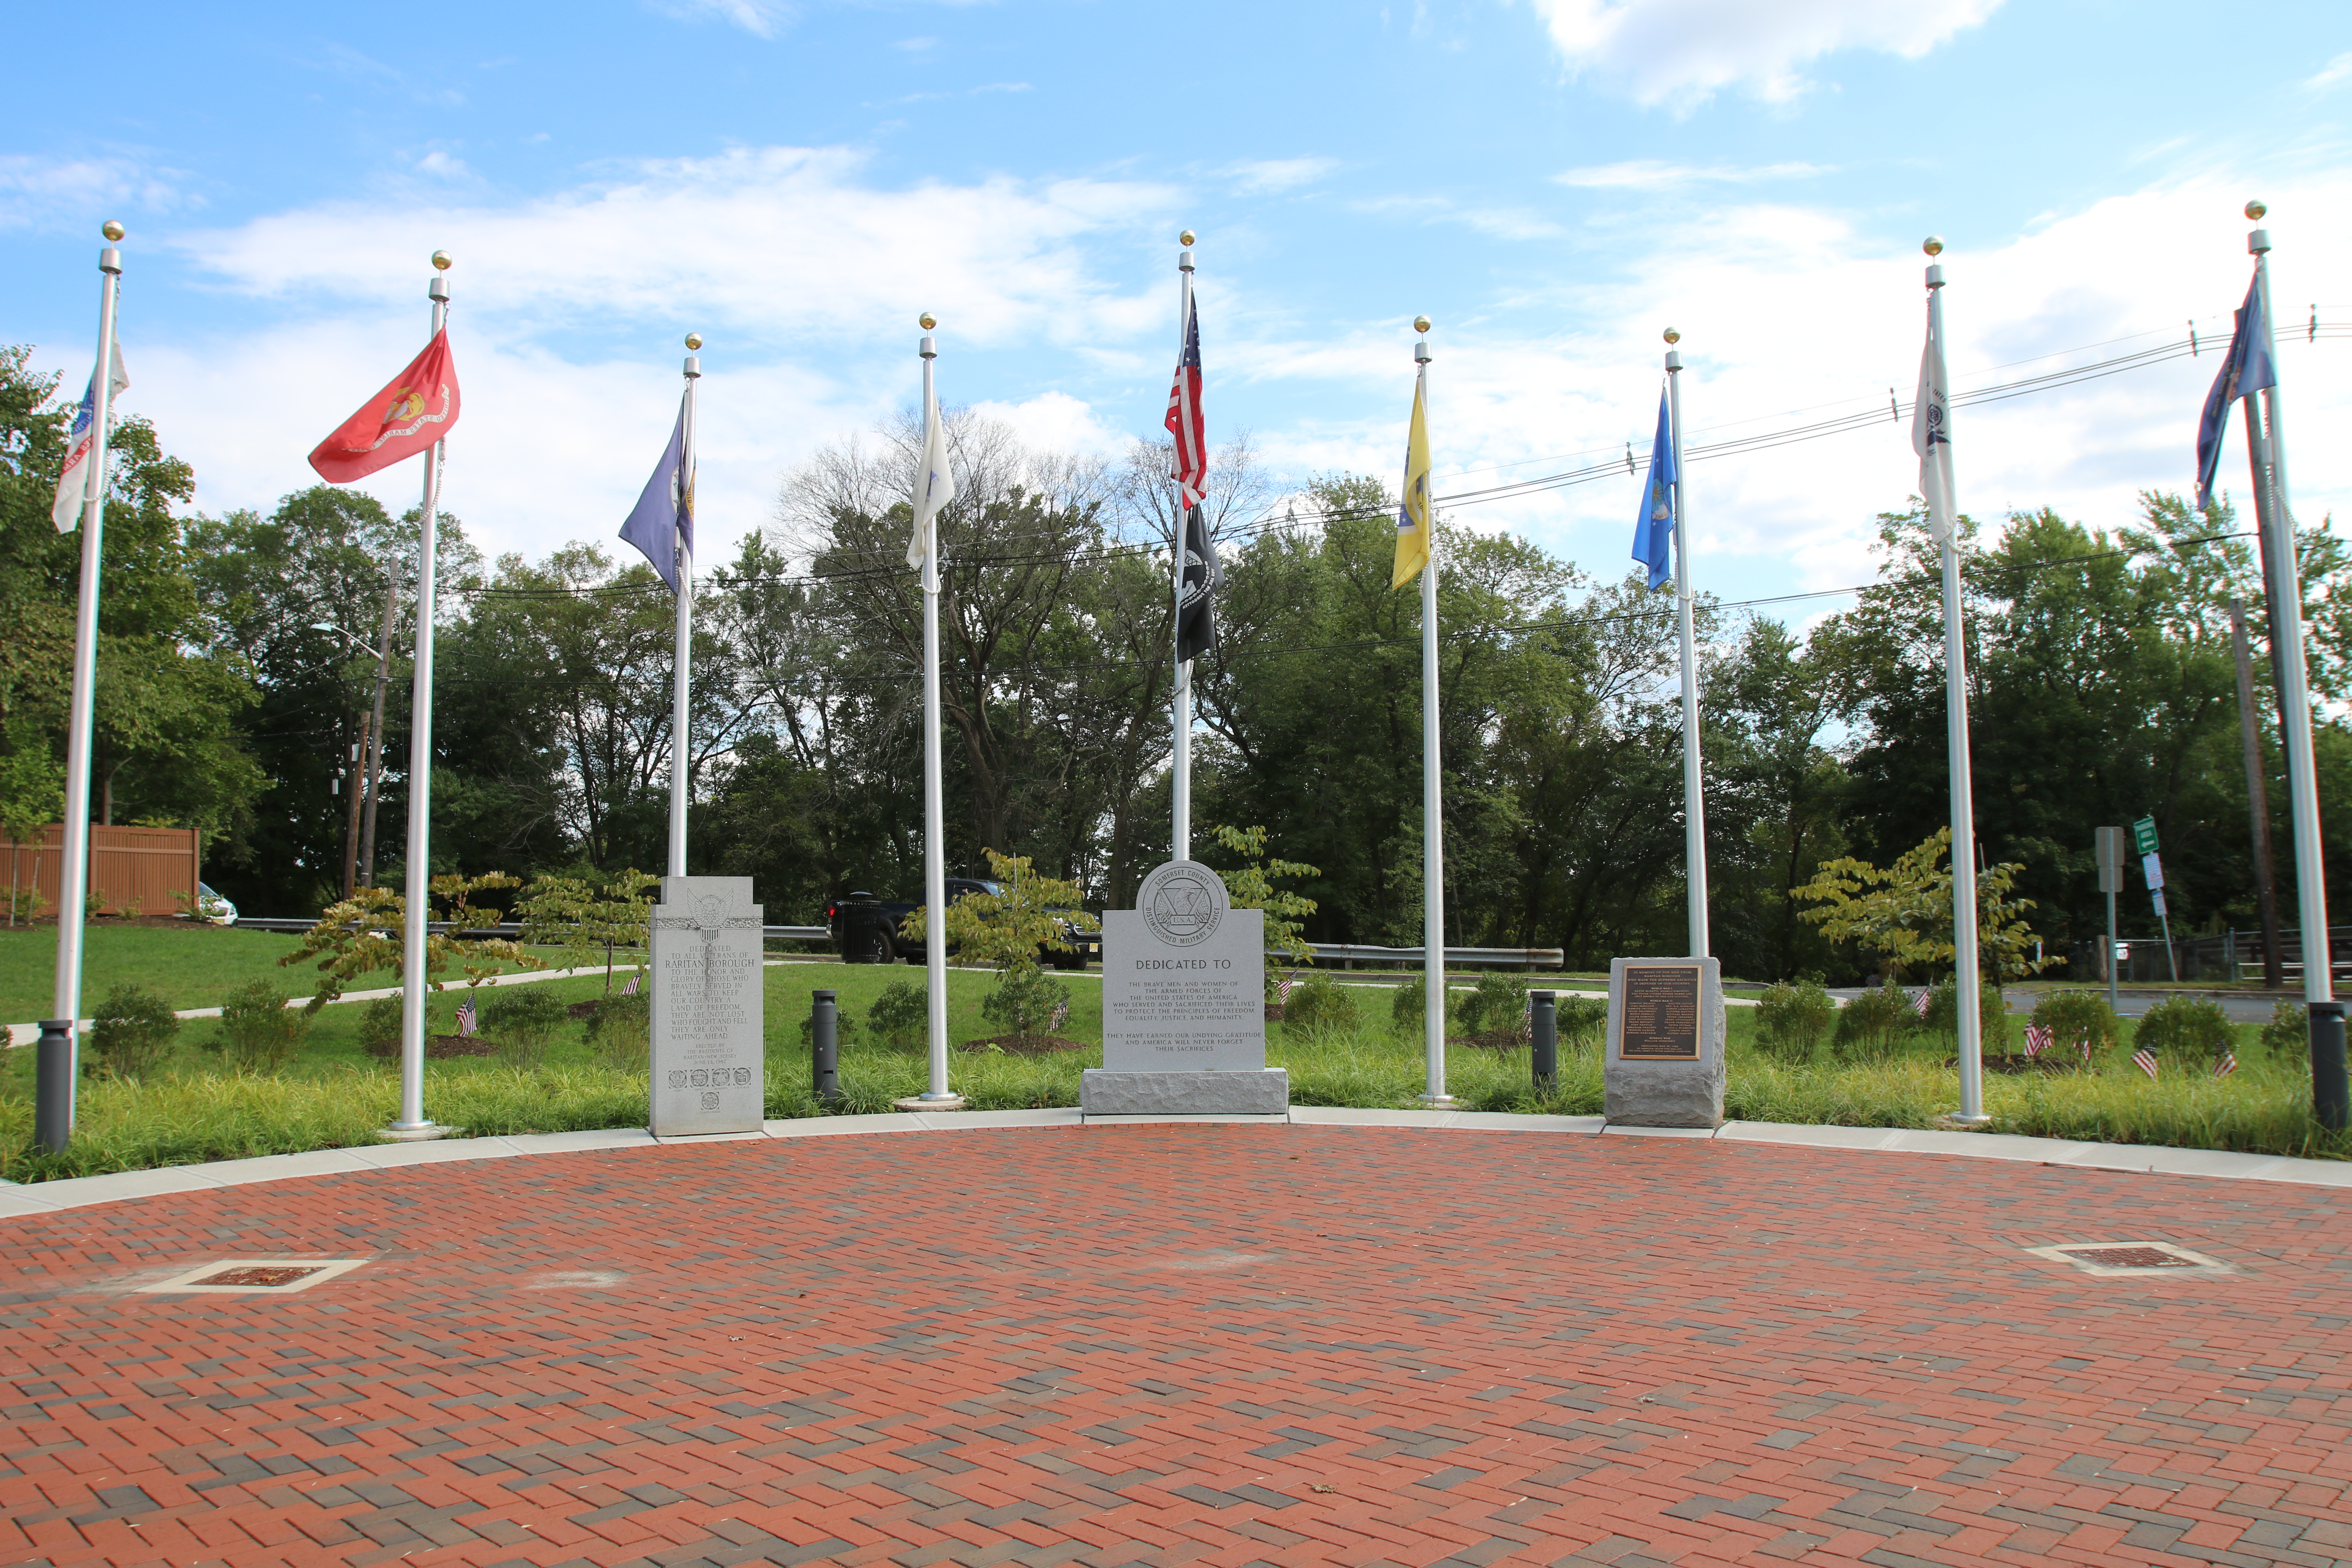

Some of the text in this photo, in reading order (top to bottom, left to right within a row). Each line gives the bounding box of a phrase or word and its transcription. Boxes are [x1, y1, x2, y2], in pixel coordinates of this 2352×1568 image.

[1155, 870, 1211, 887] SOMERSET COUNTY
[1145, 907, 1220, 944] DISTINGUISHED MILITARY SERVICE
[709, 959, 754, 967] BOROUGH
[1136, 960, 1231, 969] DEDICATED TO
